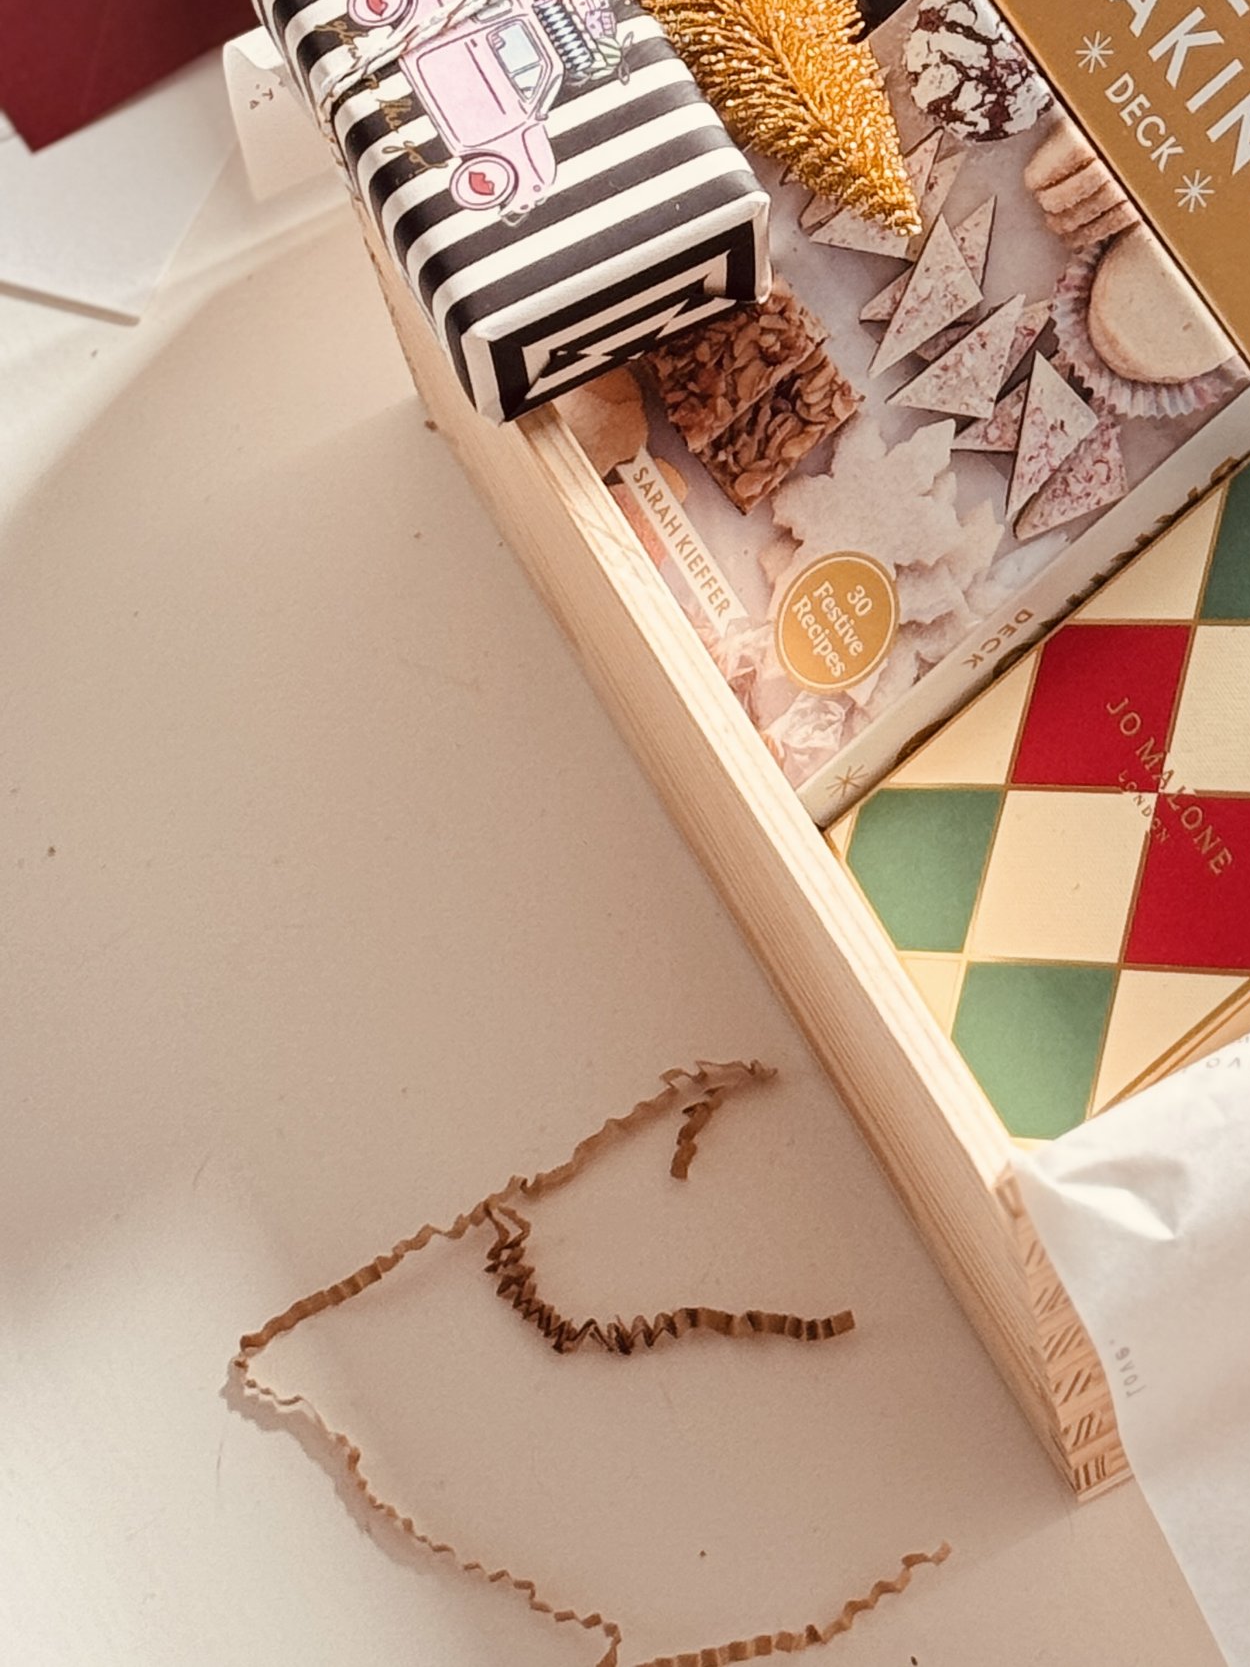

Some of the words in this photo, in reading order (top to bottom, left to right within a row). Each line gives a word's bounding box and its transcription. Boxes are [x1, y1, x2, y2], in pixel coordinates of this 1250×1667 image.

[1105, 73, 1184, 172] DECK
[632, 466, 681, 539] SARAH
[677, 536, 731, 619] KIEFFER
[792, 596, 846, 678] Recipes
[812, 581, 863, 657] Festive
[846, 585, 873, 618] 30
[963, 609, 1034, 669] DECK
[1107, 697, 1141, 737] JO
[1136, 736, 1234, 876] MALONE
[1118, 771, 1169, 843] LONDON
